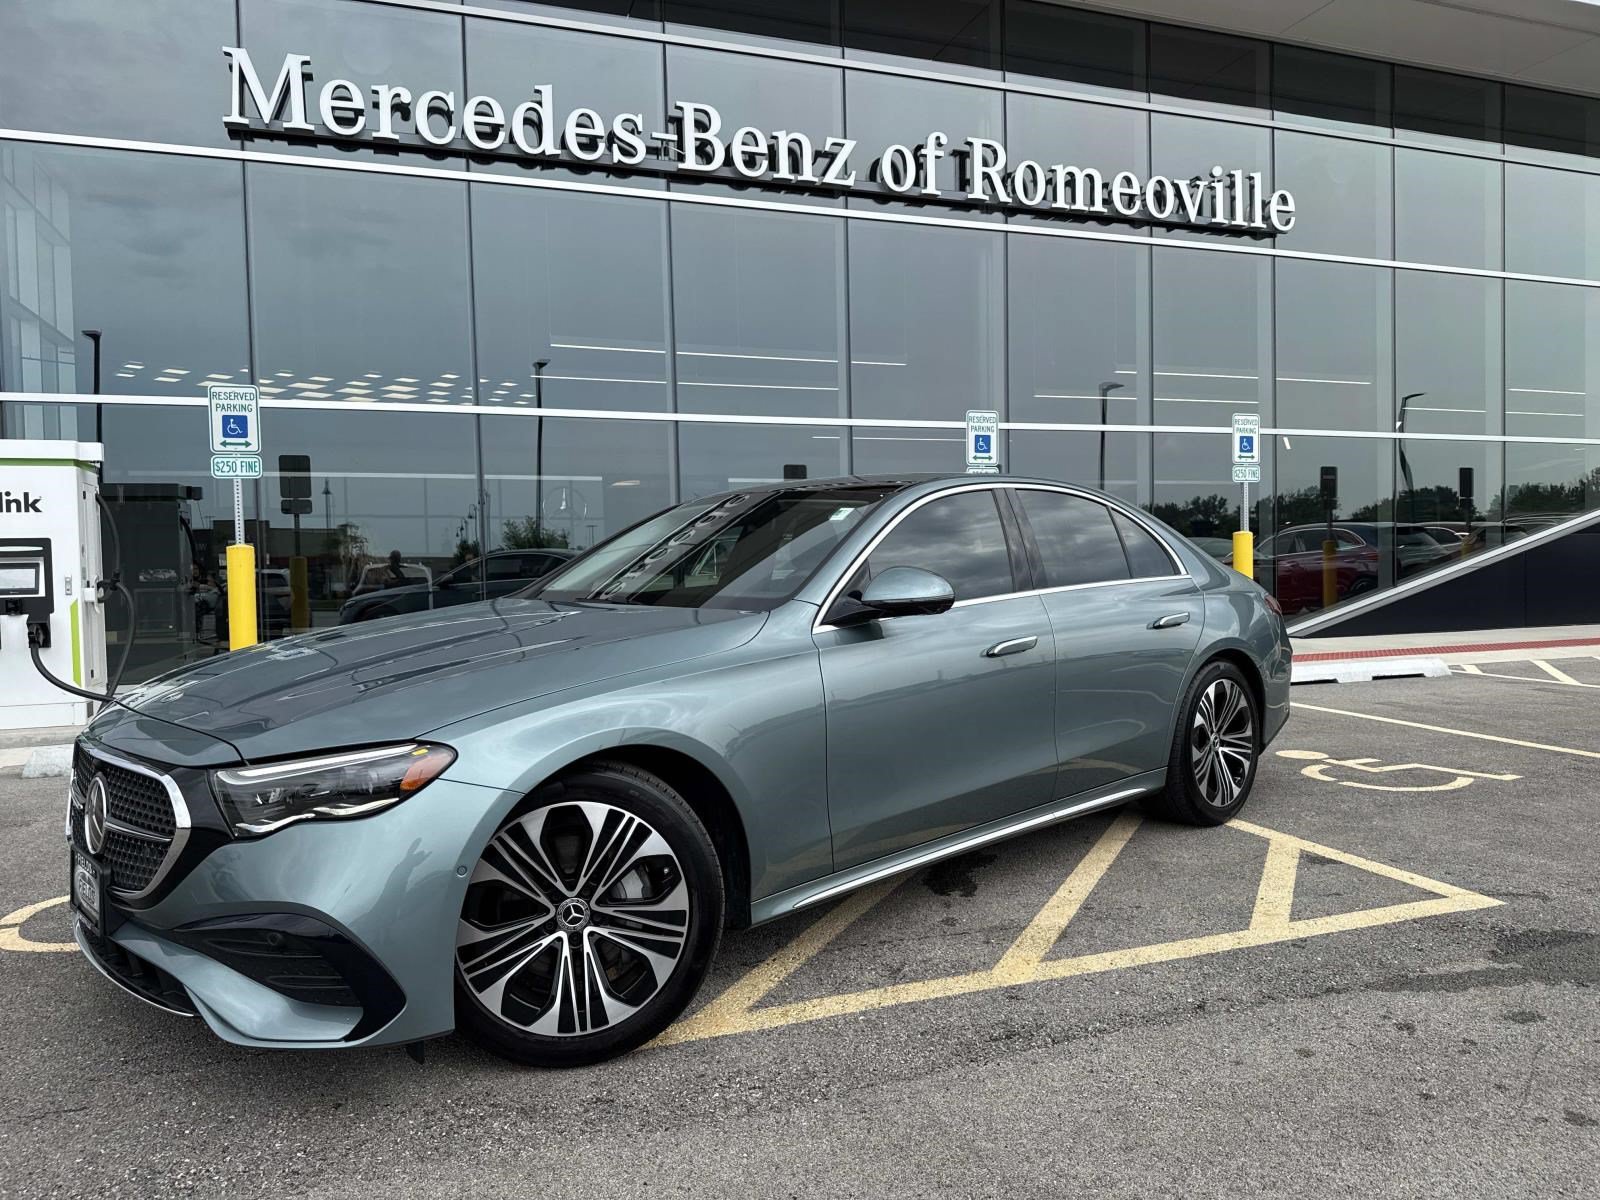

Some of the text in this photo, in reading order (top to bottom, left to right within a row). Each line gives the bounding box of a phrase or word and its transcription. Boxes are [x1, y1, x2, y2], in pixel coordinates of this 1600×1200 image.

[222, 46, 1297, 232] Mercedes-Benz of Romeoville
[212, 391, 255, 401] RESERVED
[215, 403, 253, 412] PARKING
[968, 416, 996, 424] RESERVED
[1234, 418, 1258, 426] RESERVED
[970, 425, 995, 433] PARKING
[215, 461, 259, 473] $250 FINE
[1234, 469, 1259, 479] $250 FINE
